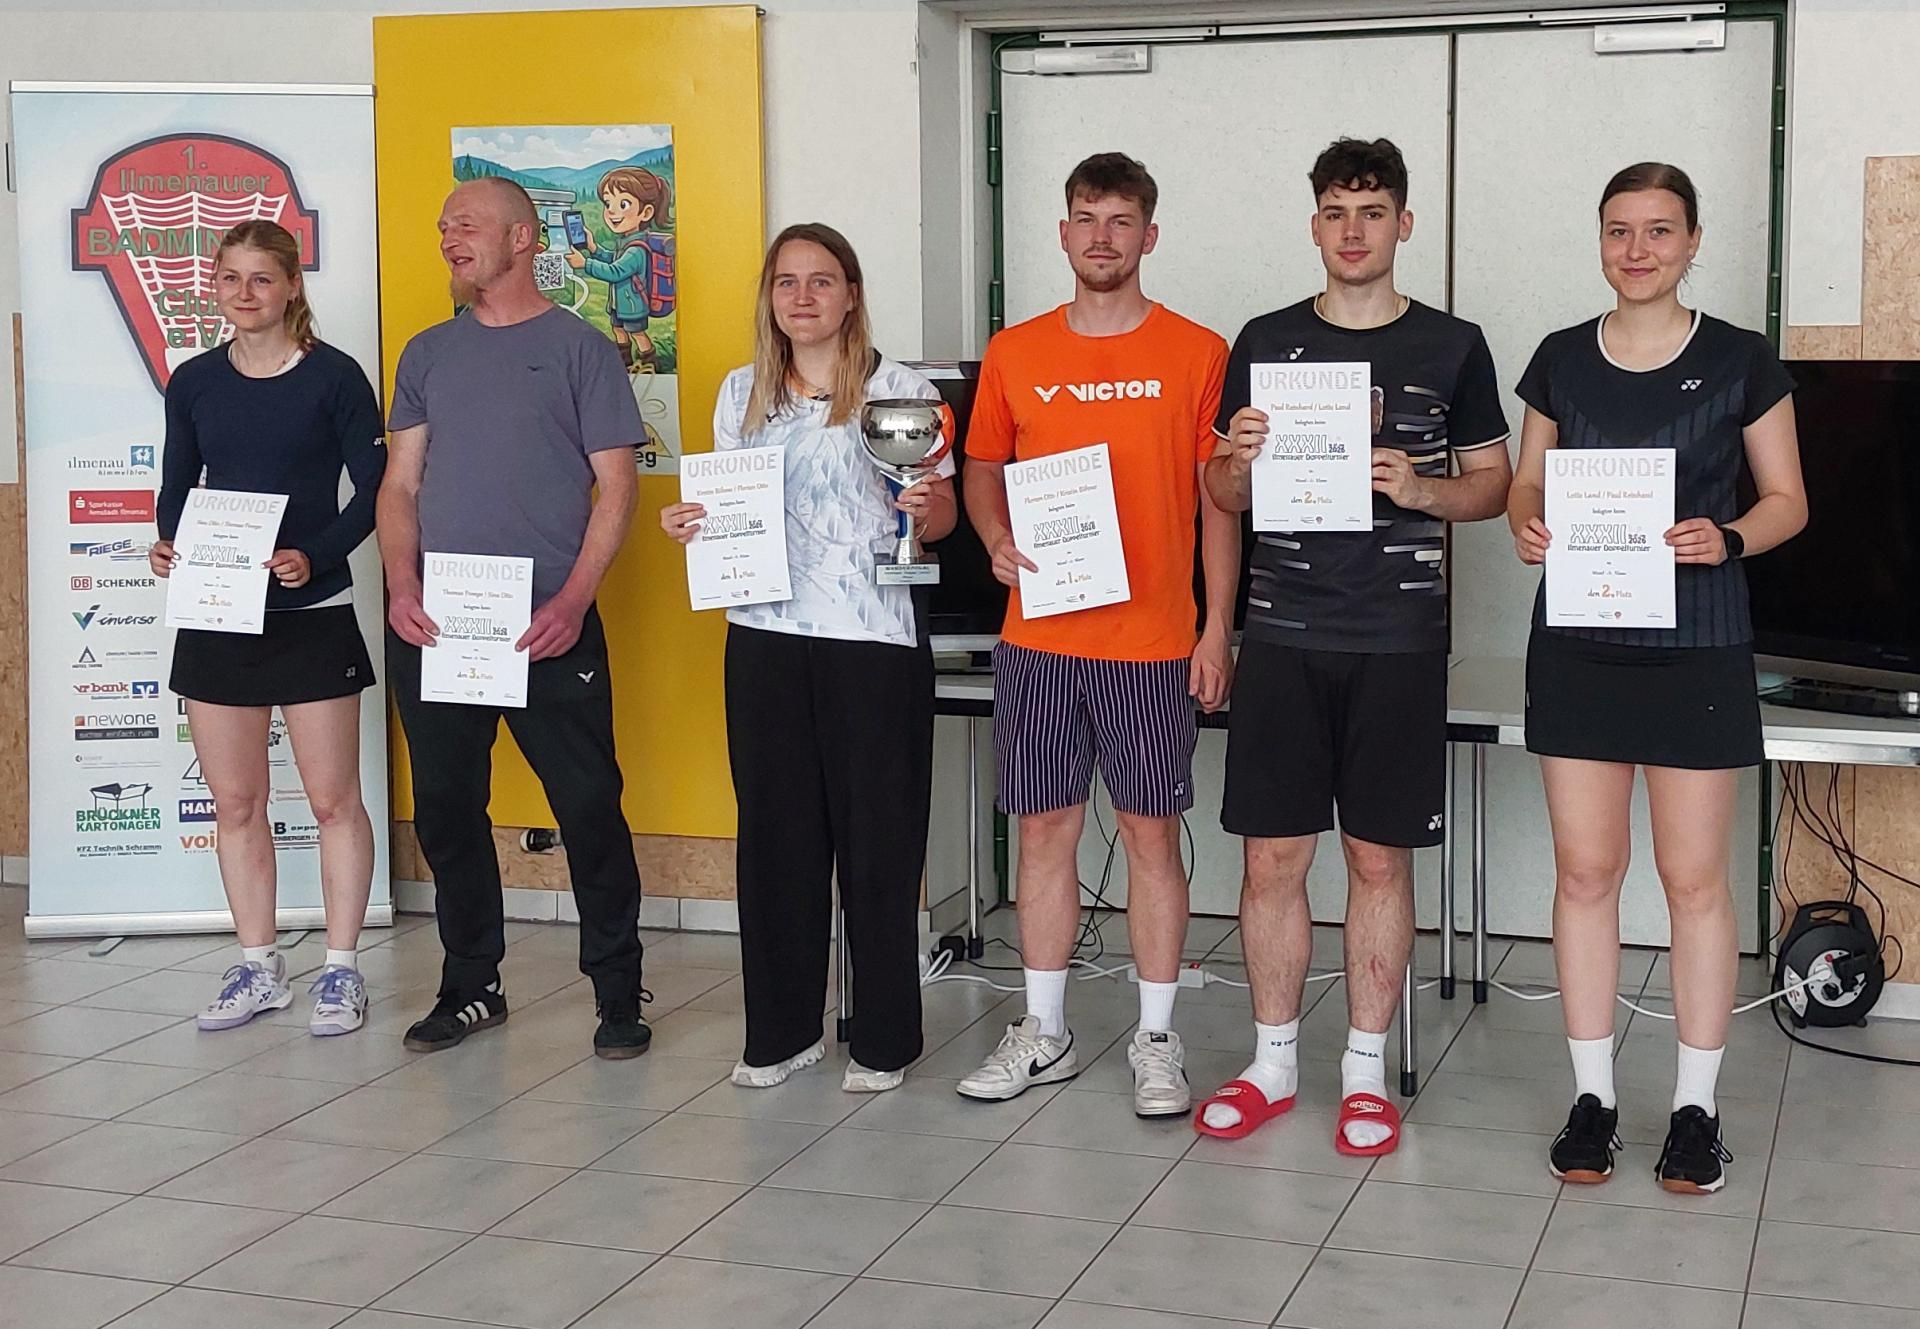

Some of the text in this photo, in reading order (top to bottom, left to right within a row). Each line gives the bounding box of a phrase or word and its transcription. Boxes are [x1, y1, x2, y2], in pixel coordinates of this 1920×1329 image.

[181, 145, 207, 171] 1.
[120, 168, 270, 192] Ilmenauer
[88, 228, 304, 257] BADMIN
[156, 289, 221, 317] Clu
[1259, 371, 1363, 390] URKUNDE
[1065, 379, 1162, 402] VICTOR
[687, 453, 778, 478] URKUNDE
[1012, 452, 1102, 486] URKUNDE
[1555, 458, 1667, 477] URKUNDE
[193, 494, 280, 514] URKUNDE
[88, 539, 132, 557] RIEGE
[432, 560, 526, 581] URKUNDE
[74, 578, 156, 588] DB SCHENKER
[97, 613, 158, 625] inverso
[88, 714, 156, 726] newone
[76, 806, 160, 822] BRÜCKNER
[76, 820, 160, 832] KARTONAGEN
[94, 844, 124, 852] Technik
